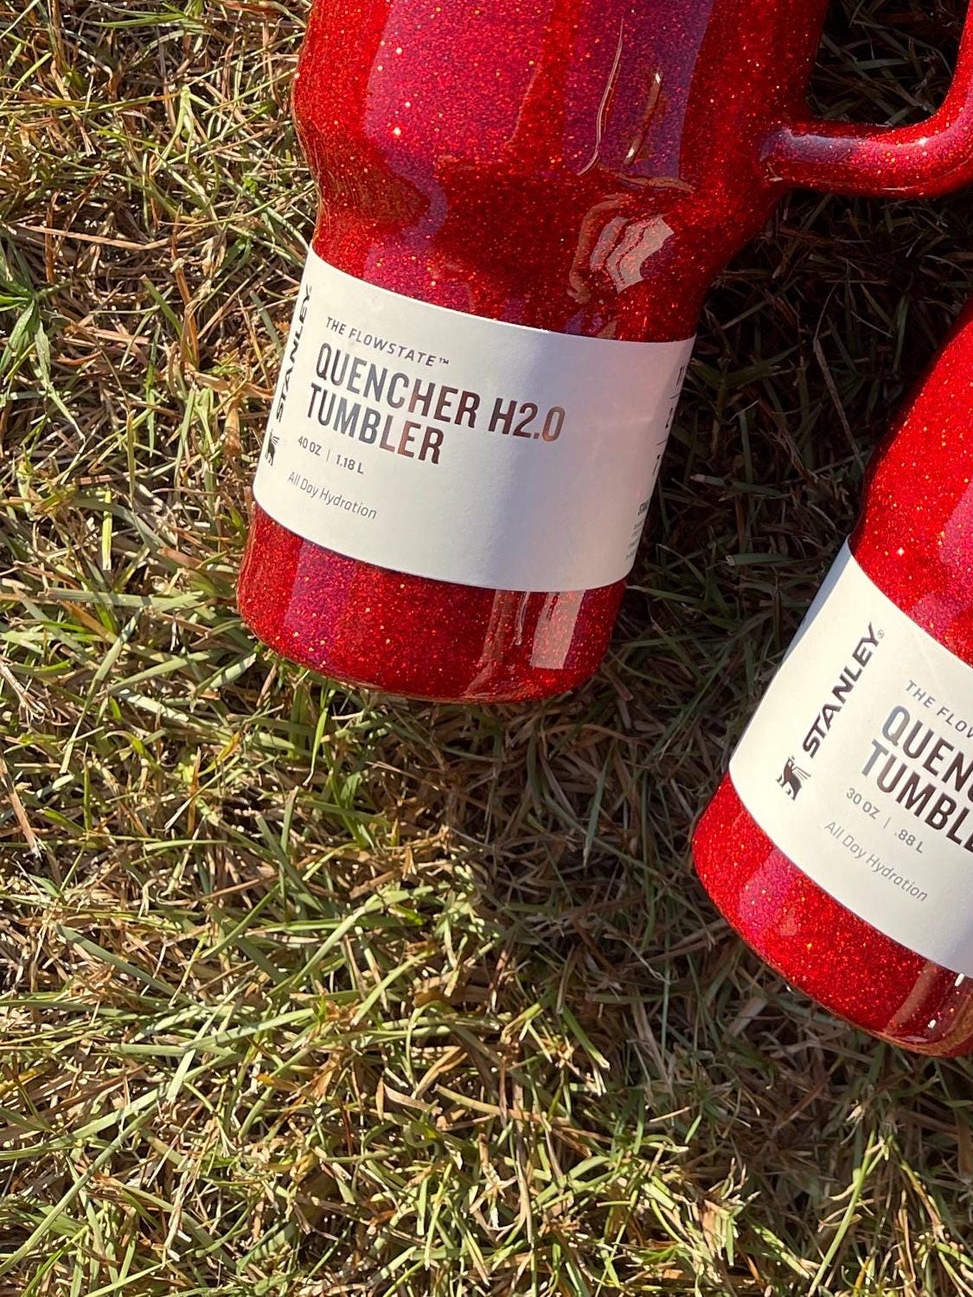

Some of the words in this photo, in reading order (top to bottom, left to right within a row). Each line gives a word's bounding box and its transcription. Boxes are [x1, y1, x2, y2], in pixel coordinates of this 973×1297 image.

[326, 316, 347, 335] THE
[315, 342, 481, 429] QUENCHER
[488, 397, 567, 443] H2.0
[307, 382, 445, 465] TUMBLER
[298, 435, 308, 449] 40
[309, 442, 322, 456] OZ
[336, 454, 356, 470] 1.18
[357, 462, 364, 475] L
[288, 471, 301, 486] All
[300, 478, 319, 498] Day
[319, 487, 377, 519] Hydration
[905, 680, 936, 709] THE
[846, 787, 862, 805] 30
[862, 801, 881, 820] OZ
[916, 841, 923, 853] L
[824, 821, 845, 839] All
[842, 834, 867, 859] Day
[866, 854, 928, 902] Hydration
